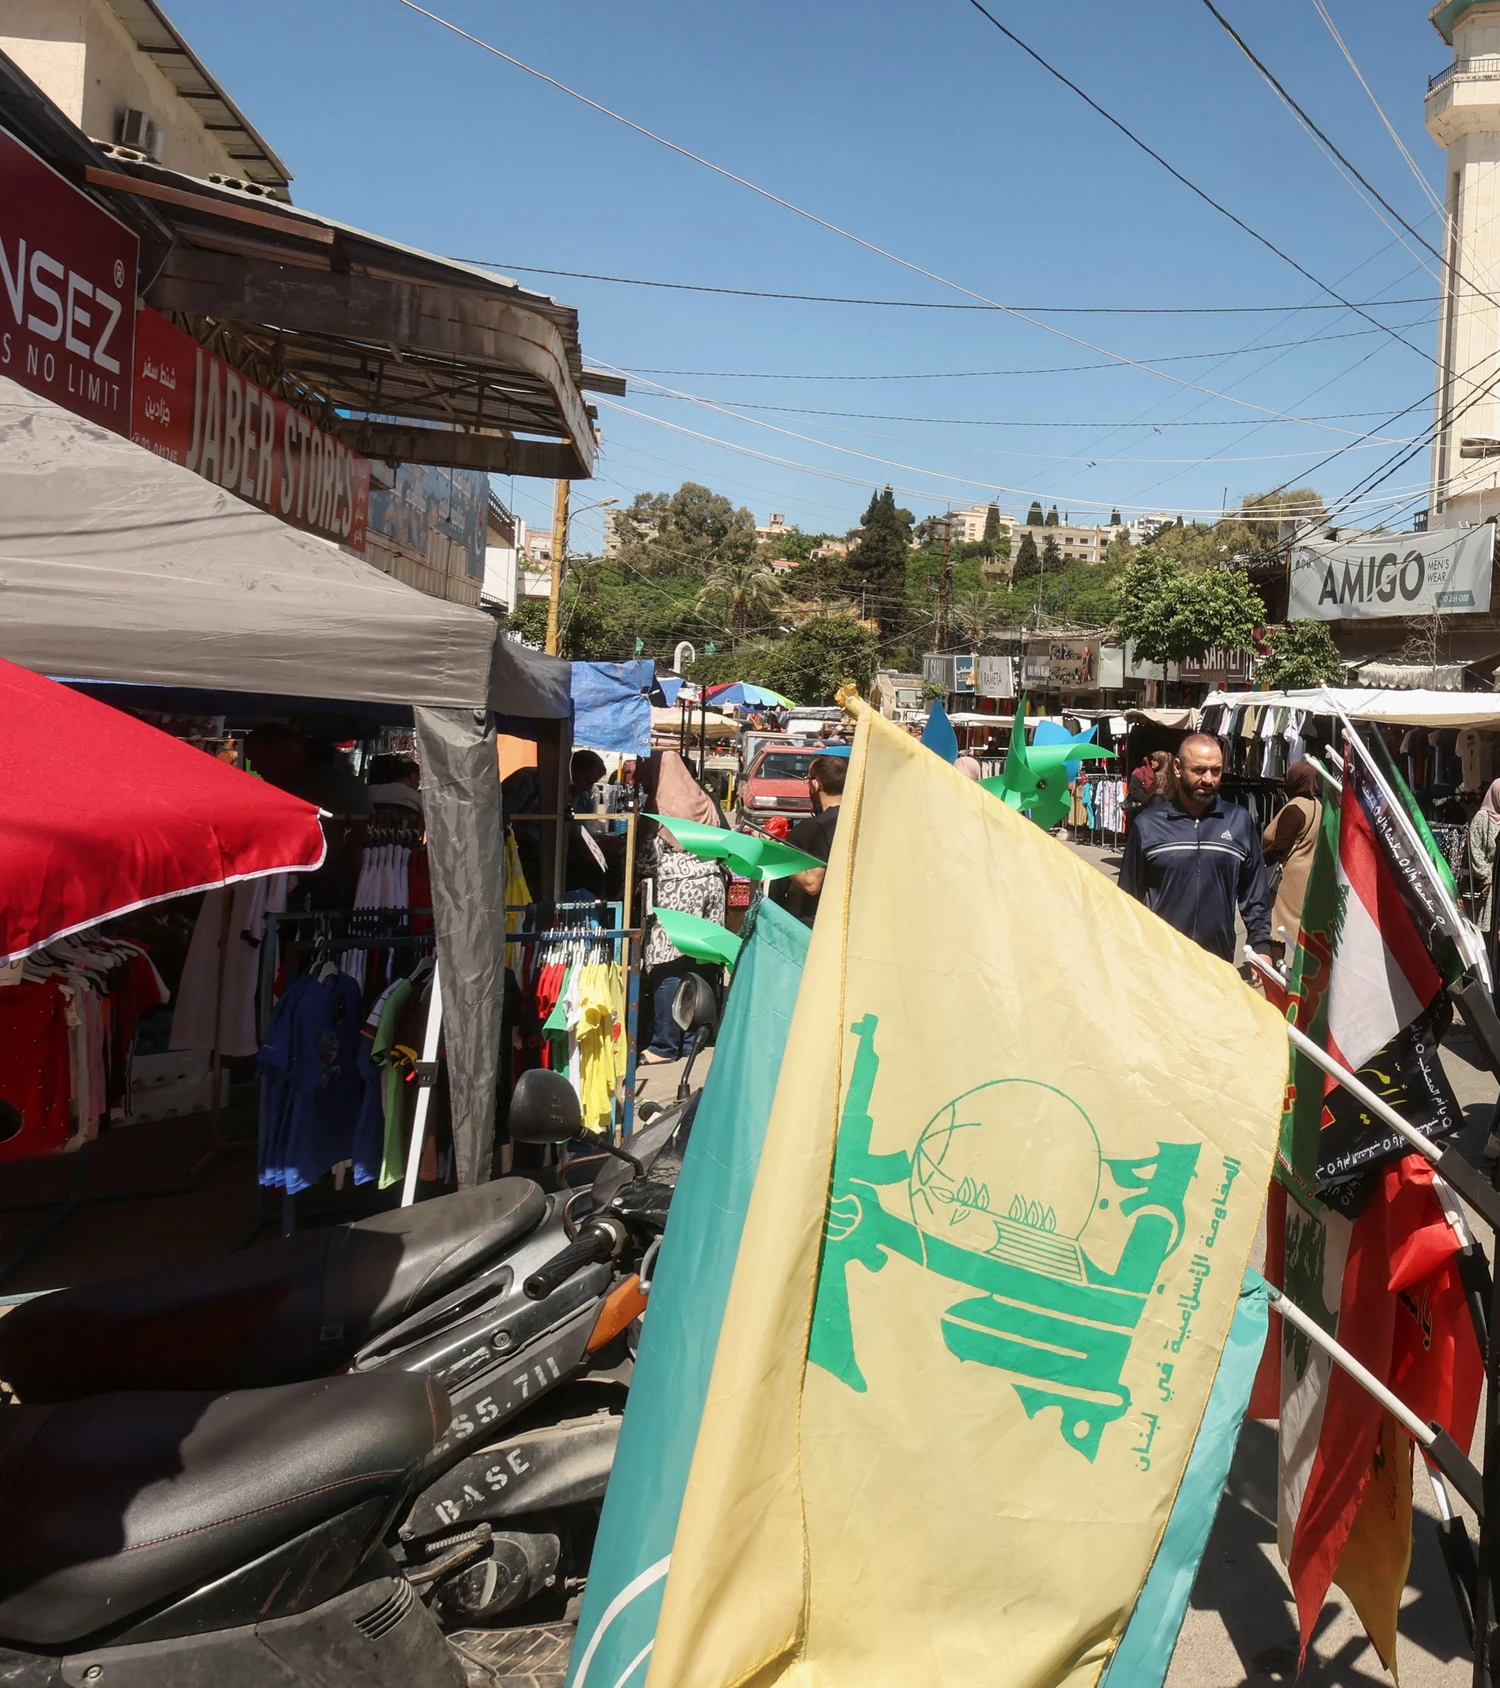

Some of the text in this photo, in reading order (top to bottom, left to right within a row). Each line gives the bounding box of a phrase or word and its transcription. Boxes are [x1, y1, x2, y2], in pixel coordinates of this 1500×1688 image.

[27, 344, 55, 383] NO
[68, 363, 120, 411] LIMIT
[142, 356, 176, 390] شنط سفر
[186, 347, 275, 504] JABER
[280, 408, 354, 538] STORES
[1318, 550, 1426, 606] AMIGO
[1427, 572, 1447, 583] WEAR
[1428, 558, 1450, 571] MEN'S
[1199, 1154, 1242, 1248] المقاومة
[1155, 1361, 1176, 1402] في
[1130, 1411, 1161, 1472] لبنان
[435, 1447, 530, 1525] BASE
